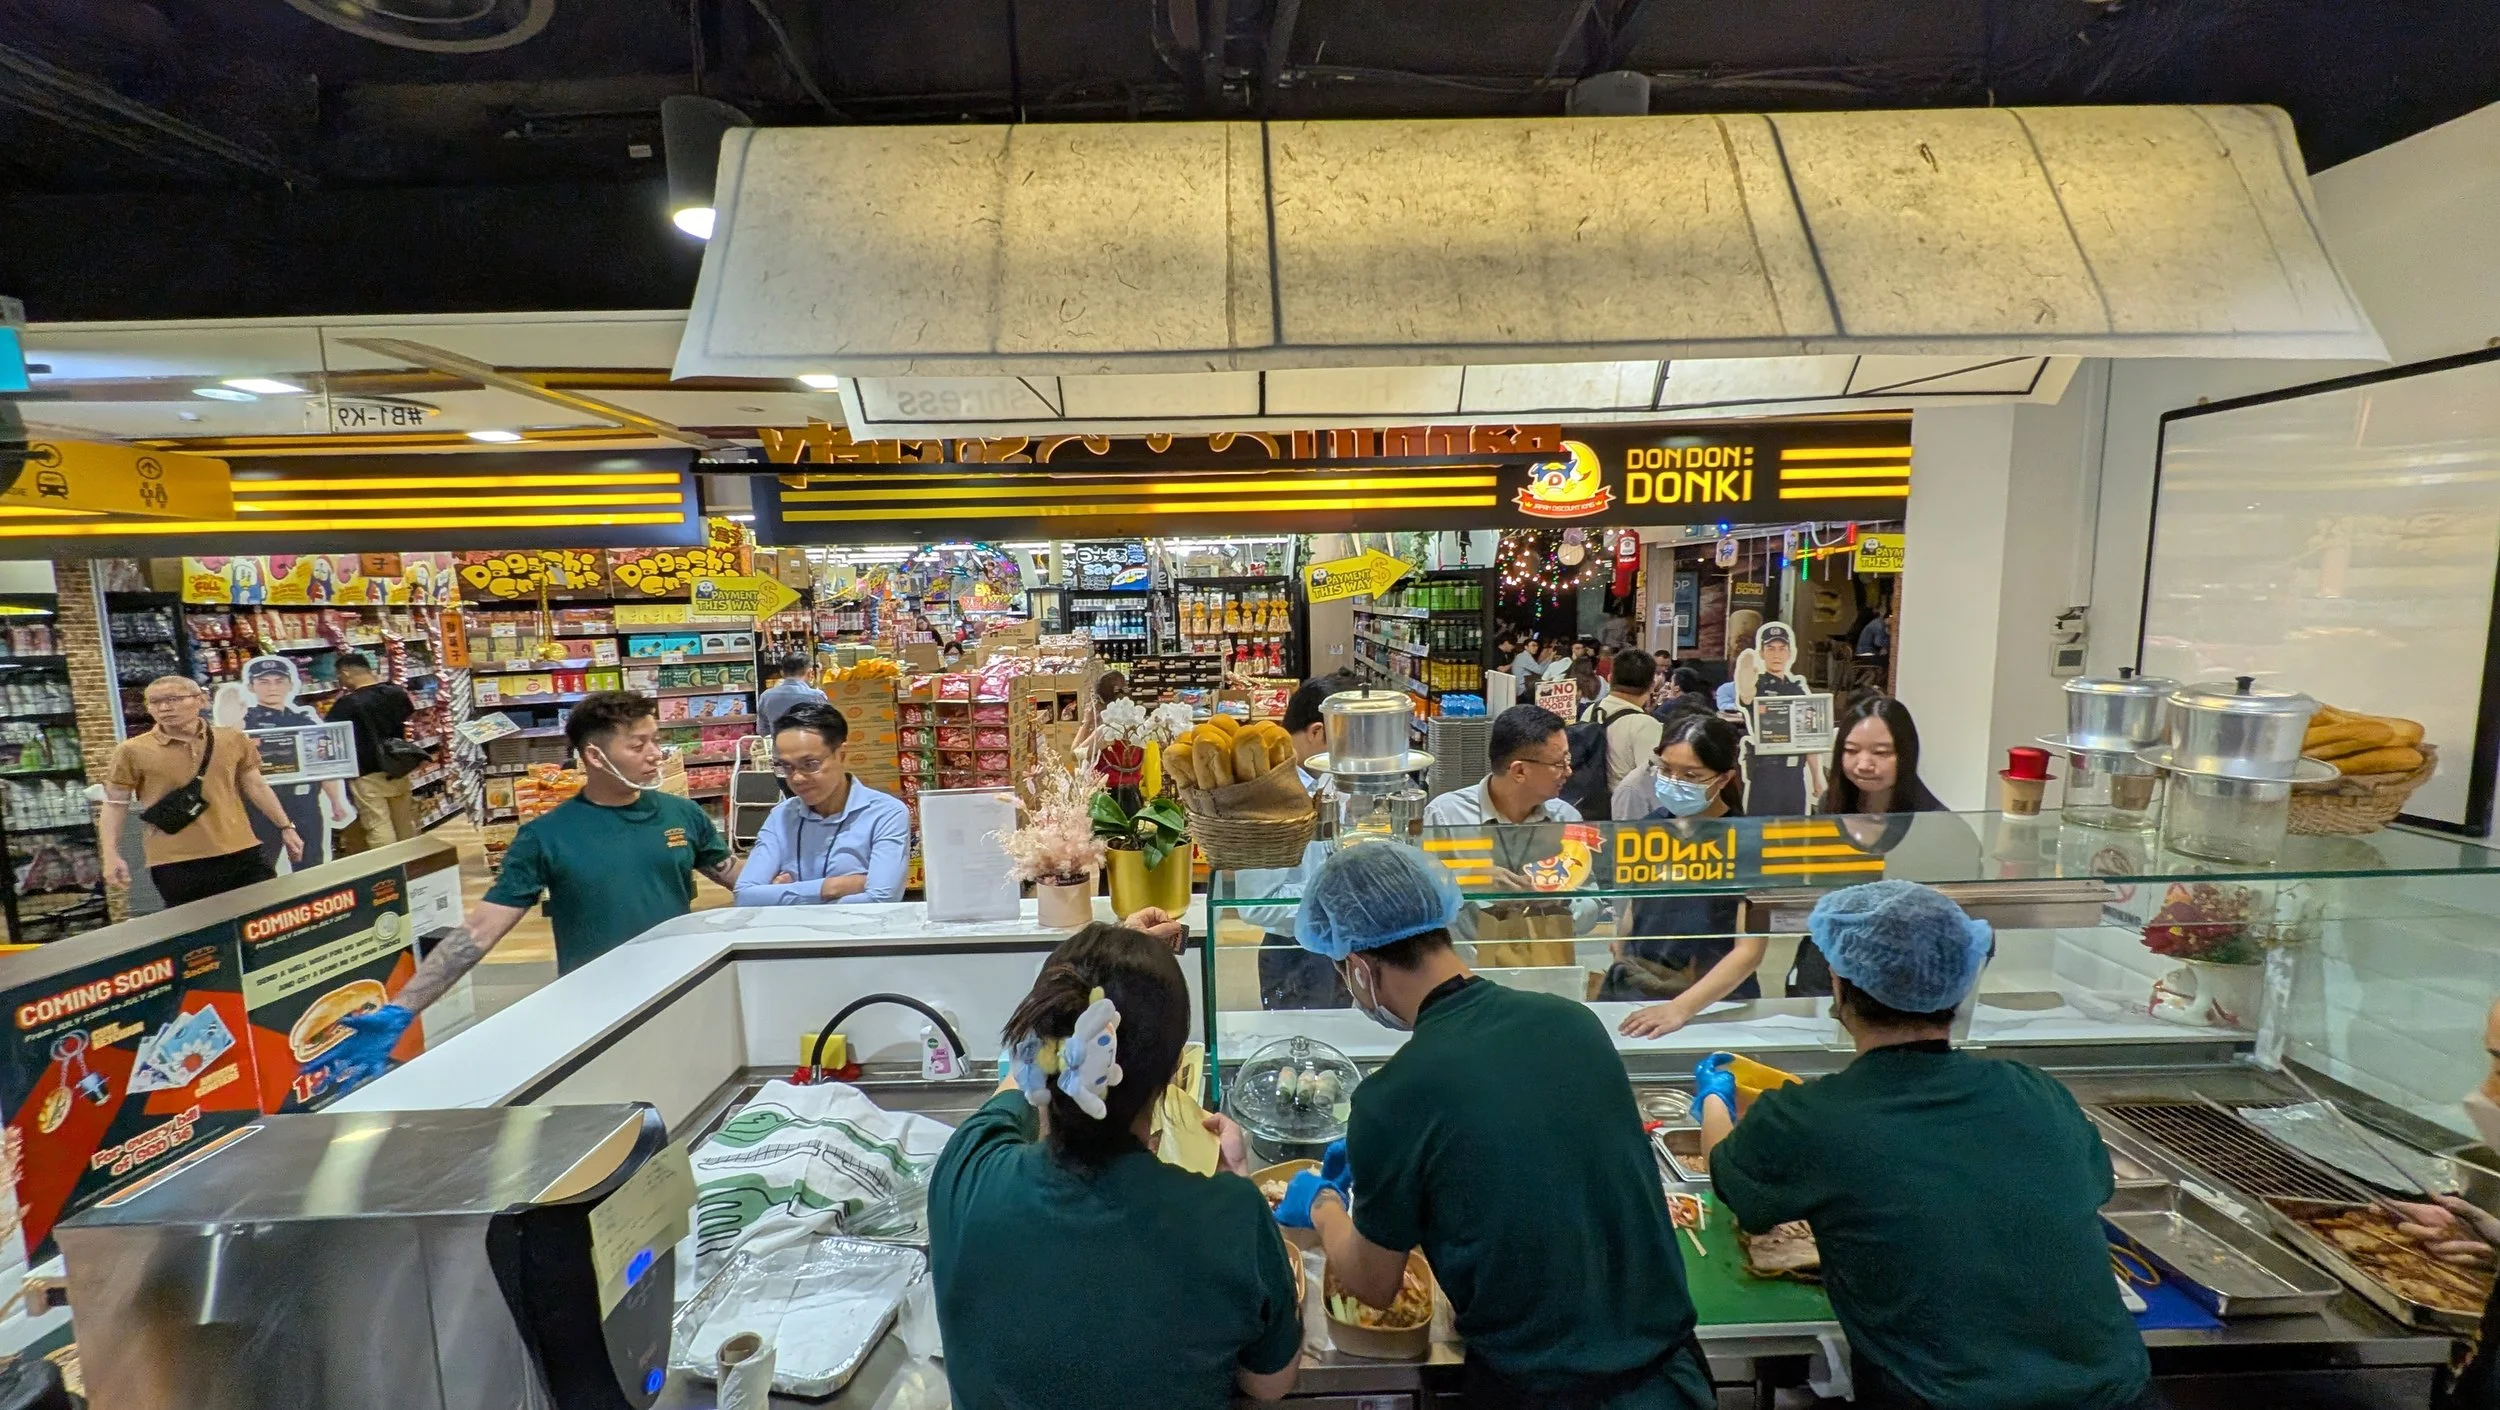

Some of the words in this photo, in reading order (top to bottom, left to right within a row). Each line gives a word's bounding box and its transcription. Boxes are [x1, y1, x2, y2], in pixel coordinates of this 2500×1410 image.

[1626, 470, 1753, 504] DONKI
[460, 550, 596, 590] Dagashi
[614, 548, 735, 588] Dagashi
[1862, 557, 1889, 567] THIS
[1326, 568, 1371, 586] PAYMENT
[711, 590, 759, 601] PAYMENT
[1312, 583, 1342, 599] THIS
[1345, 578, 1372, 593] WAY
[696, 600, 728, 612] THIS
[730, 600, 760, 612] WAY
[1554, 683, 1574, 695] NO
[1539, 695, 1573, 705] OUTSIDE
[248, 907, 311, 939] COMING
[313, 891, 355, 917] SOON
[256, 973, 278, 986] SEND
[287, 962, 306, 973] WELL
[328, 948, 343, 958] FOR
[22, 980, 112, 1026] COMING
[114, 960, 173, 993] SOON
[92, 1144, 124, 1166] For
[125, 1124, 171, 1151] every
[111, 1156, 134, 1173] of
